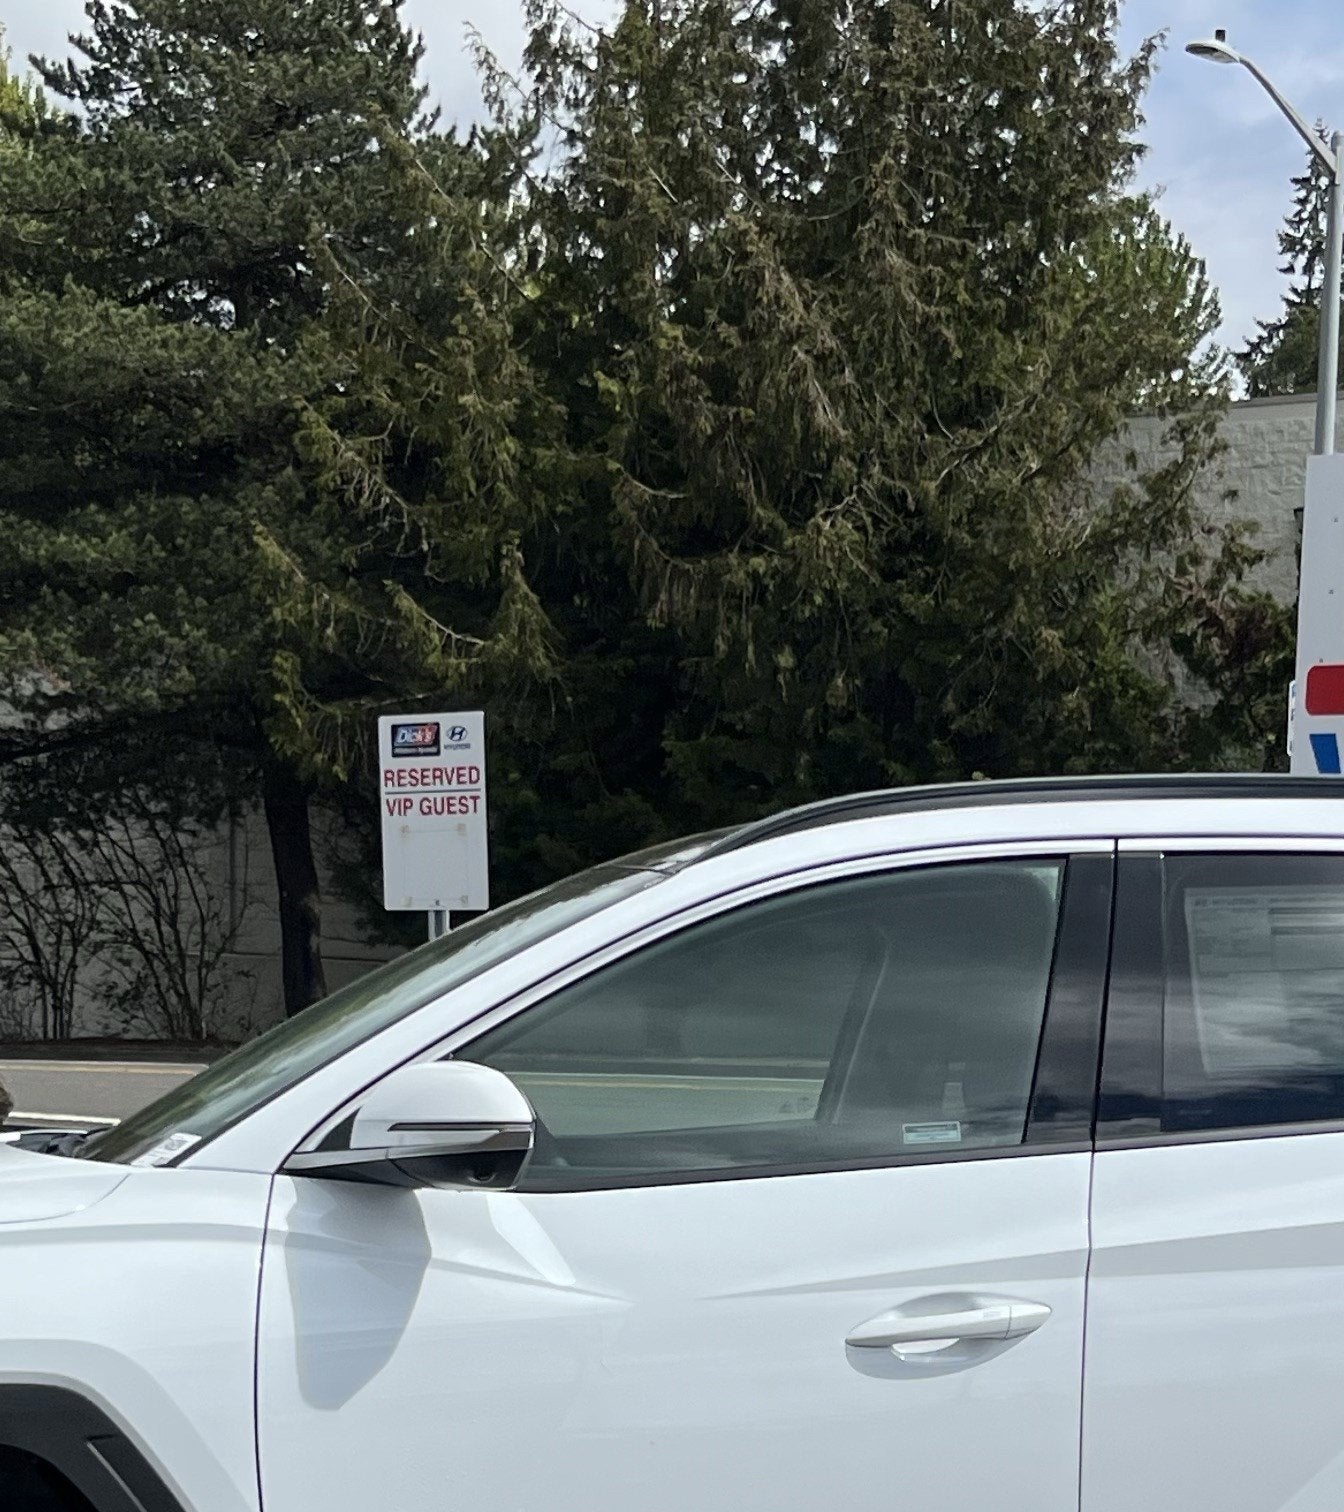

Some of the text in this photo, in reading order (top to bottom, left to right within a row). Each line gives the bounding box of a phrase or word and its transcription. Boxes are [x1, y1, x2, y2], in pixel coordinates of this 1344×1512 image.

[384, 766, 480, 787] RESERVED
[386, 796, 480, 816] VIP GUEST
